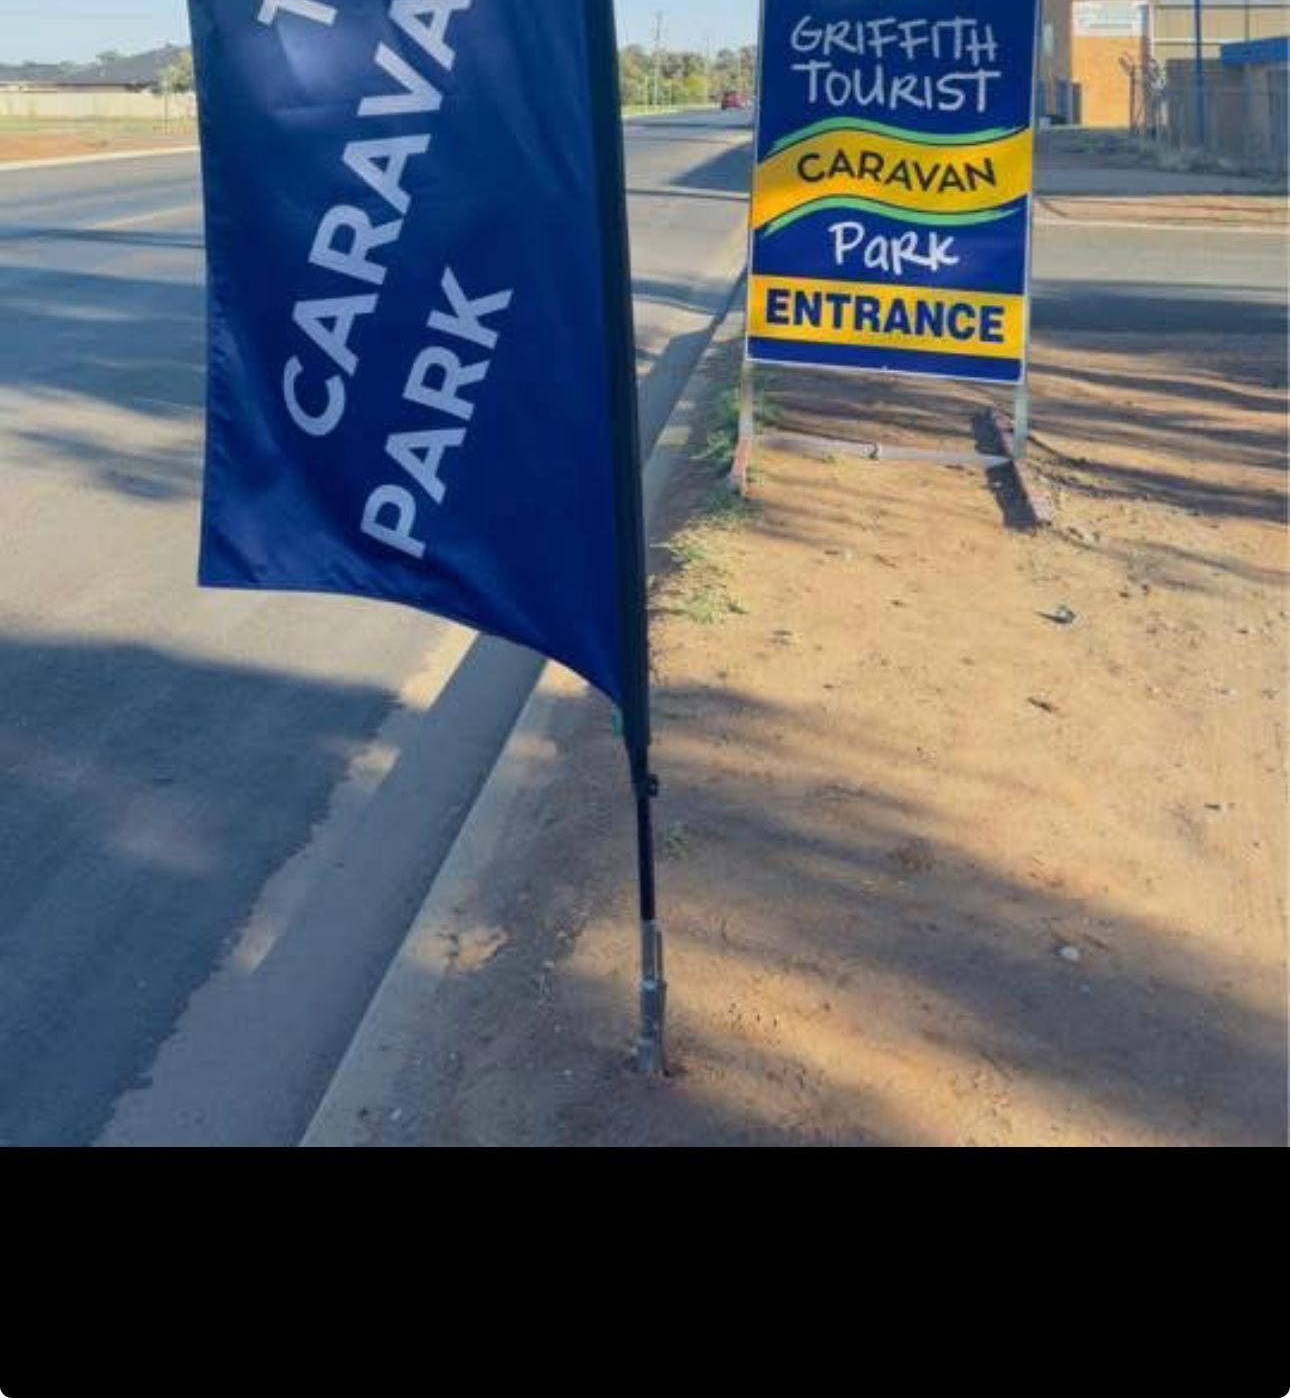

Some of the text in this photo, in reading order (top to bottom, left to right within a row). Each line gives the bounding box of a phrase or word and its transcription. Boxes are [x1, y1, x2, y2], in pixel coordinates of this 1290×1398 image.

[792, 16, 996, 65] GRIFFITH
[793, 61, 999, 112] TOURIST
[798, 150, 995, 192] CARAVAN
[766, 288, 1004, 342] ENTRANCE
[359, 267, 515, 559] PARK
